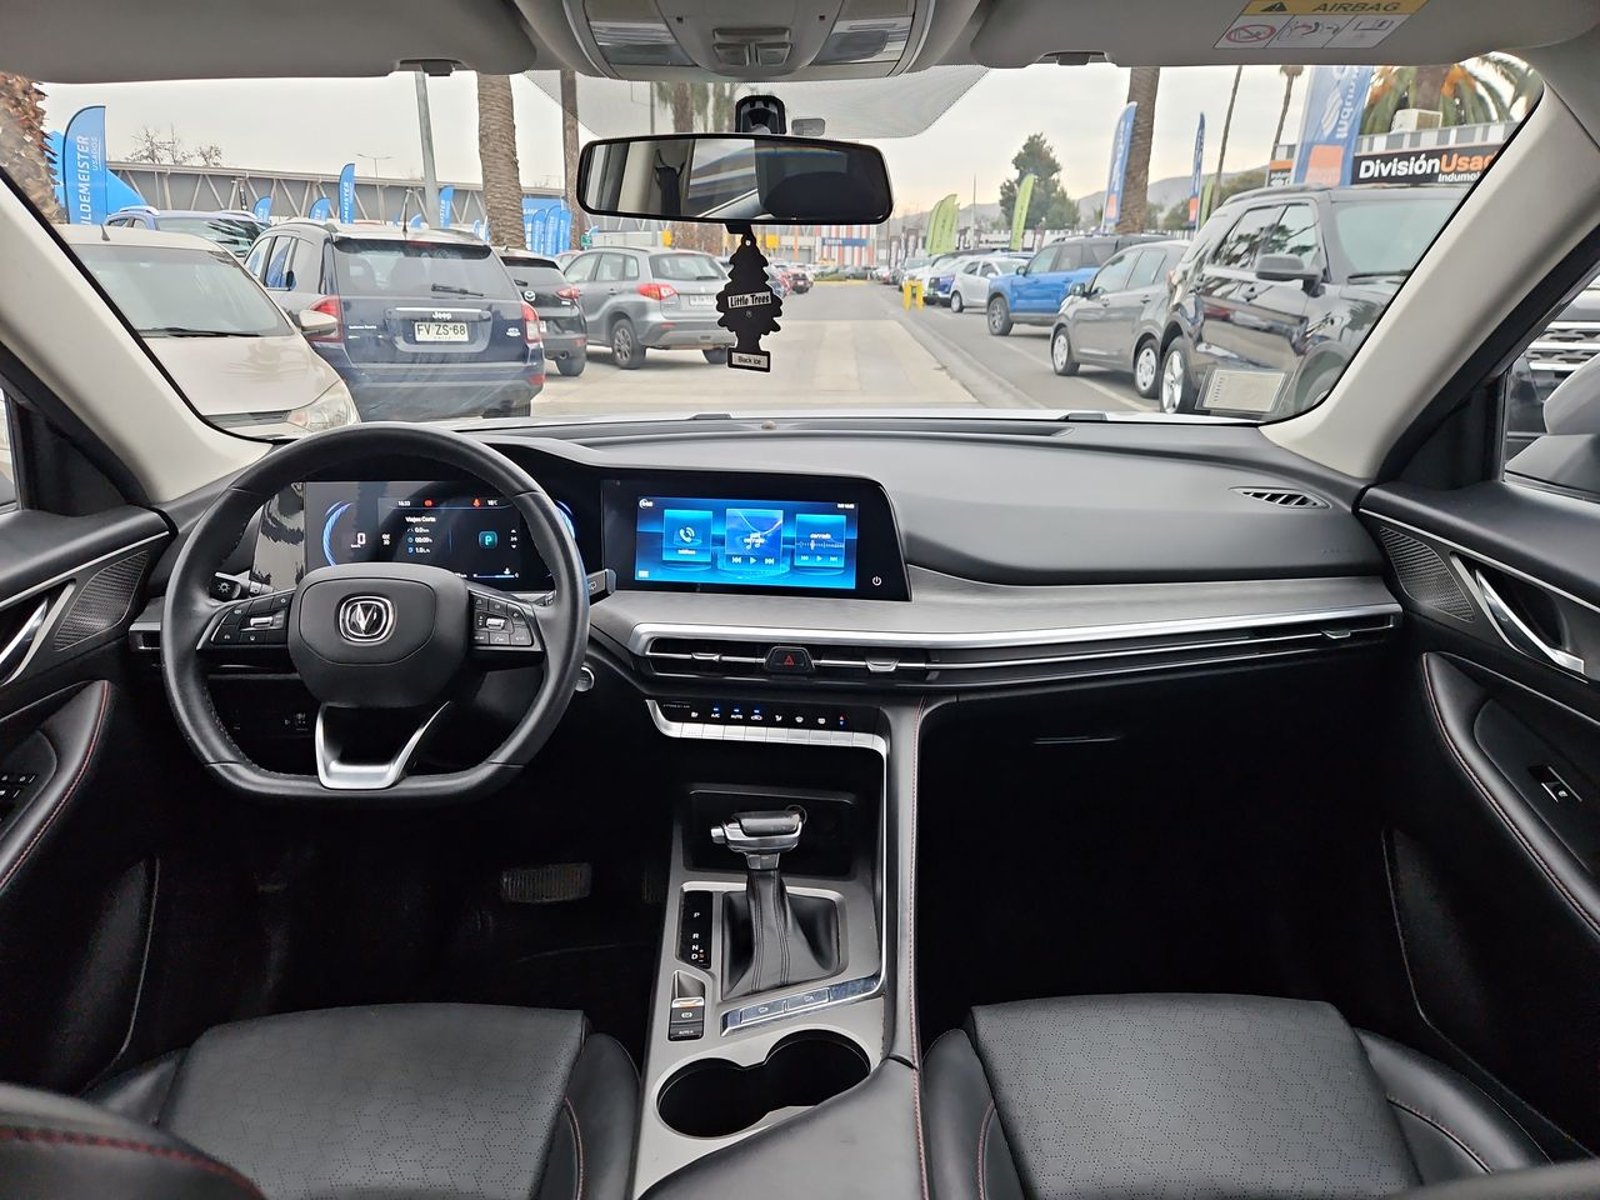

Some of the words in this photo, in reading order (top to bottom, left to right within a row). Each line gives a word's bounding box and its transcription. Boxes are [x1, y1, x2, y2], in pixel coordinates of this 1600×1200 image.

[1312, 2, 1400, 12] AIRBAG
[77, 136, 91, 224] ILDEMEISTER
[730, 296, 748, 307] Little
[750, 294, 770, 304] Trees
[432, 311, 452, 320] Jeep
[417, 323, 431, 335] FV
